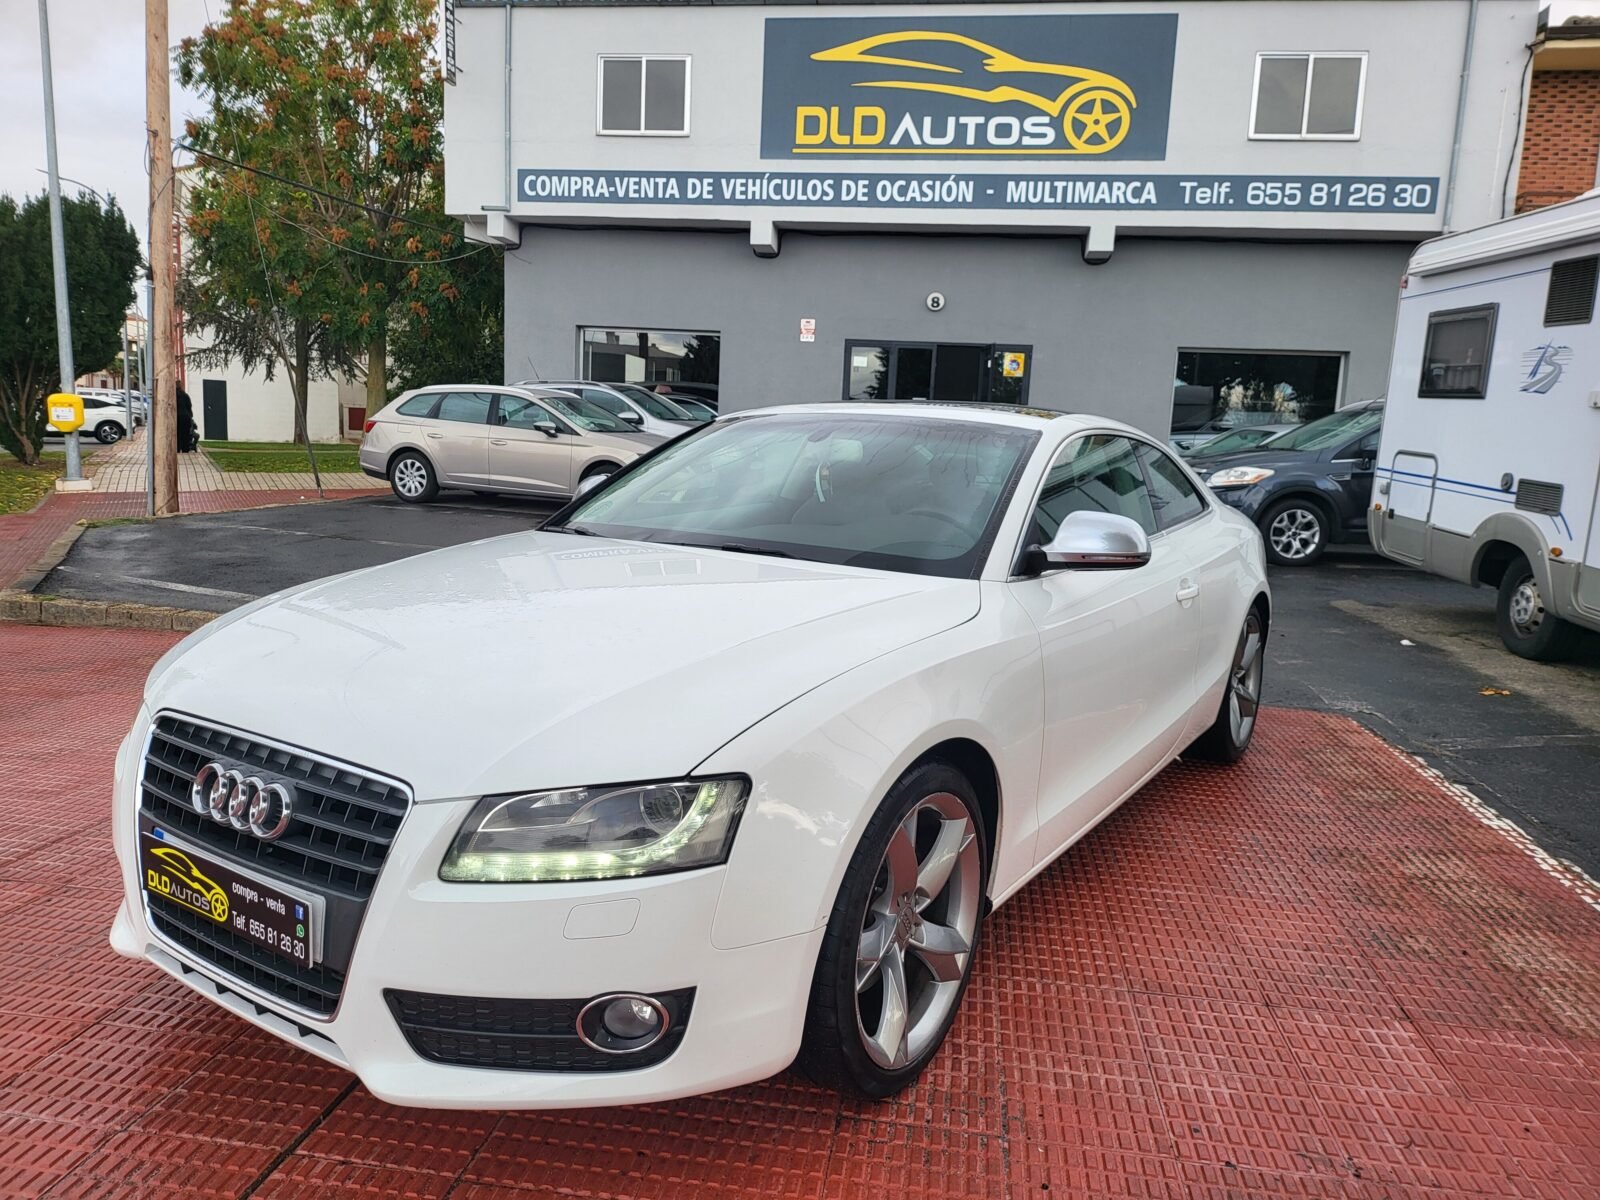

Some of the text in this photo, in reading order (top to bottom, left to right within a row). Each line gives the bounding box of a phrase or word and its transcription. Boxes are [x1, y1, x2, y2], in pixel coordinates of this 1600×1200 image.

[523, 174, 679, 199] COMPRA-VENTA
[687, 177, 714, 200] DE
[720, 173, 835, 202] VEHÍCULOS
[841, 179, 869, 202] DE
[876, 174, 974, 203] OCASIÓN
[1006, 180, 1157, 205] MULTIMARCA
[1180, 181, 1234, 205] Telf.
[1246, 182, 1302, 206] 655
[1392, 183, 1432, 208] 30
[931, 296, 940, 308] 8
[231, 881, 259, 904] compra
[266, 897, 286, 915] venta
[232, 911, 305, 960] Telf. 655 81 26 30
